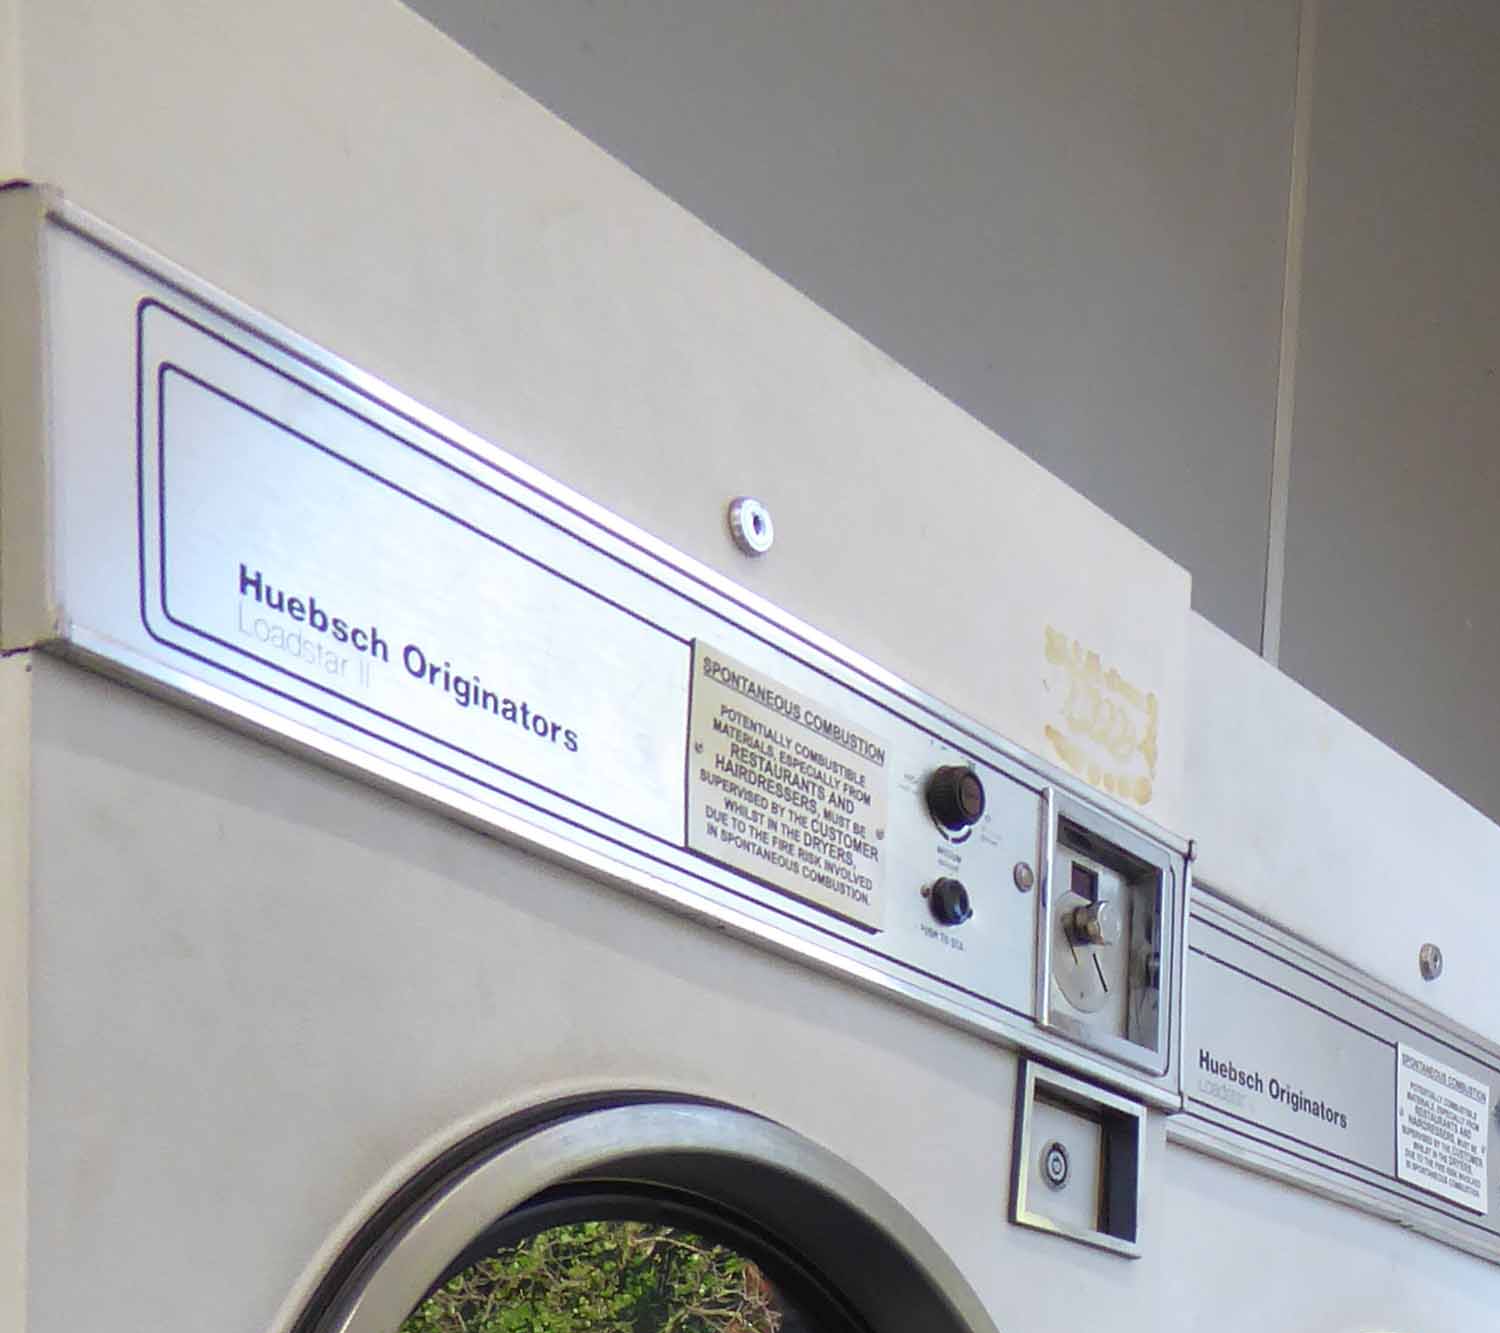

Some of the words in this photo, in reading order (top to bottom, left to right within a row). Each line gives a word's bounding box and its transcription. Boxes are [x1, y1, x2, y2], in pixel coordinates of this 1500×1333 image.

[238, 600, 348, 678] Loadstar
[239, 563, 389, 663] Huebsch
[402, 644, 579, 752] Originators
[703, 656, 800, 719] SPONTANEOUS
[804, 711, 885, 763] COMBUSTION
[721, 705, 792, 746] POTENTIALLY
[795, 742, 866, 788] COMBUSTIBLE
[700, 768, 768, 810] SUPERVISED
[771, 801, 785, 818] BY
[788, 809, 808, 829] THE
[811, 819, 879, 862] CUSTOMER
[715, 754, 820, 818] HAIRDRESSERS,
[824, 808, 850, 829] MUST
[853, 823, 866, 839] BE
[730, 743, 825, 801] RESTAURANTS
[829, 792, 855, 814] AND
[779, 751, 840, 791] ESPECIALLY
[843, 783, 871, 806] FROM
[705, 805, 729, 825] DUE
[731, 816, 746, 833] TO
[749, 825, 769, 845] THE
[772, 836, 794, 856] FIRE
[798, 846, 821, 867] RISK
[824, 860, 872, 890] INVOLVED
[706, 822, 717, 838] IN
[721, 829, 799, 874] SPONTANEOUS
[724, 798, 764, 825] WHILST
[768, 818, 778, 832] IN
[781, 823, 800, 842] THE
[1199, 1048, 1263, 1093] Huebsch
[1269, 1078, 1348, 1129] Originators
